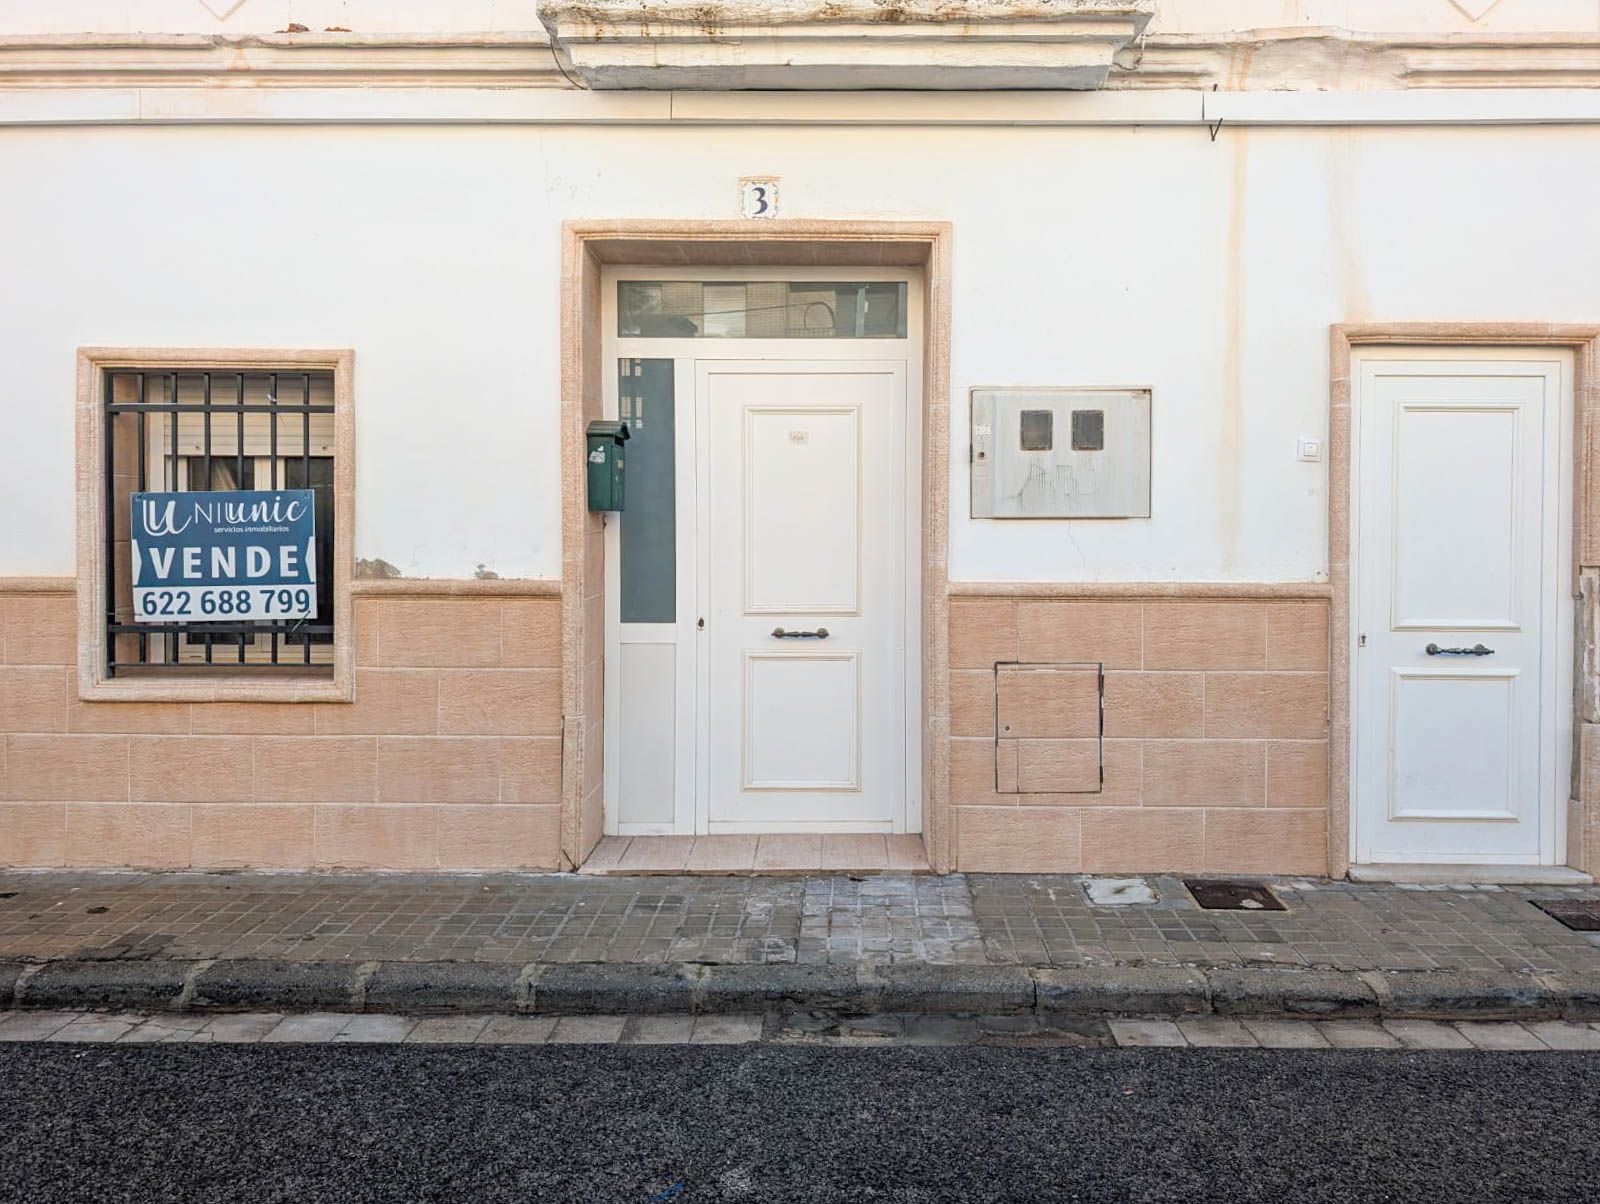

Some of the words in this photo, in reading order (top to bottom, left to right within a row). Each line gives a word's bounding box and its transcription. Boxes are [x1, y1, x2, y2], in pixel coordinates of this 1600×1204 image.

[751, 187, 768, 214] 3
[245, 525, 290, 533] inmobiliarios
[149, 545, 299, 579] VENDE
[142, 591, 191, 615] 622
[200, 590, 251, 615] 688
[259, 589, 310, 613] 799
